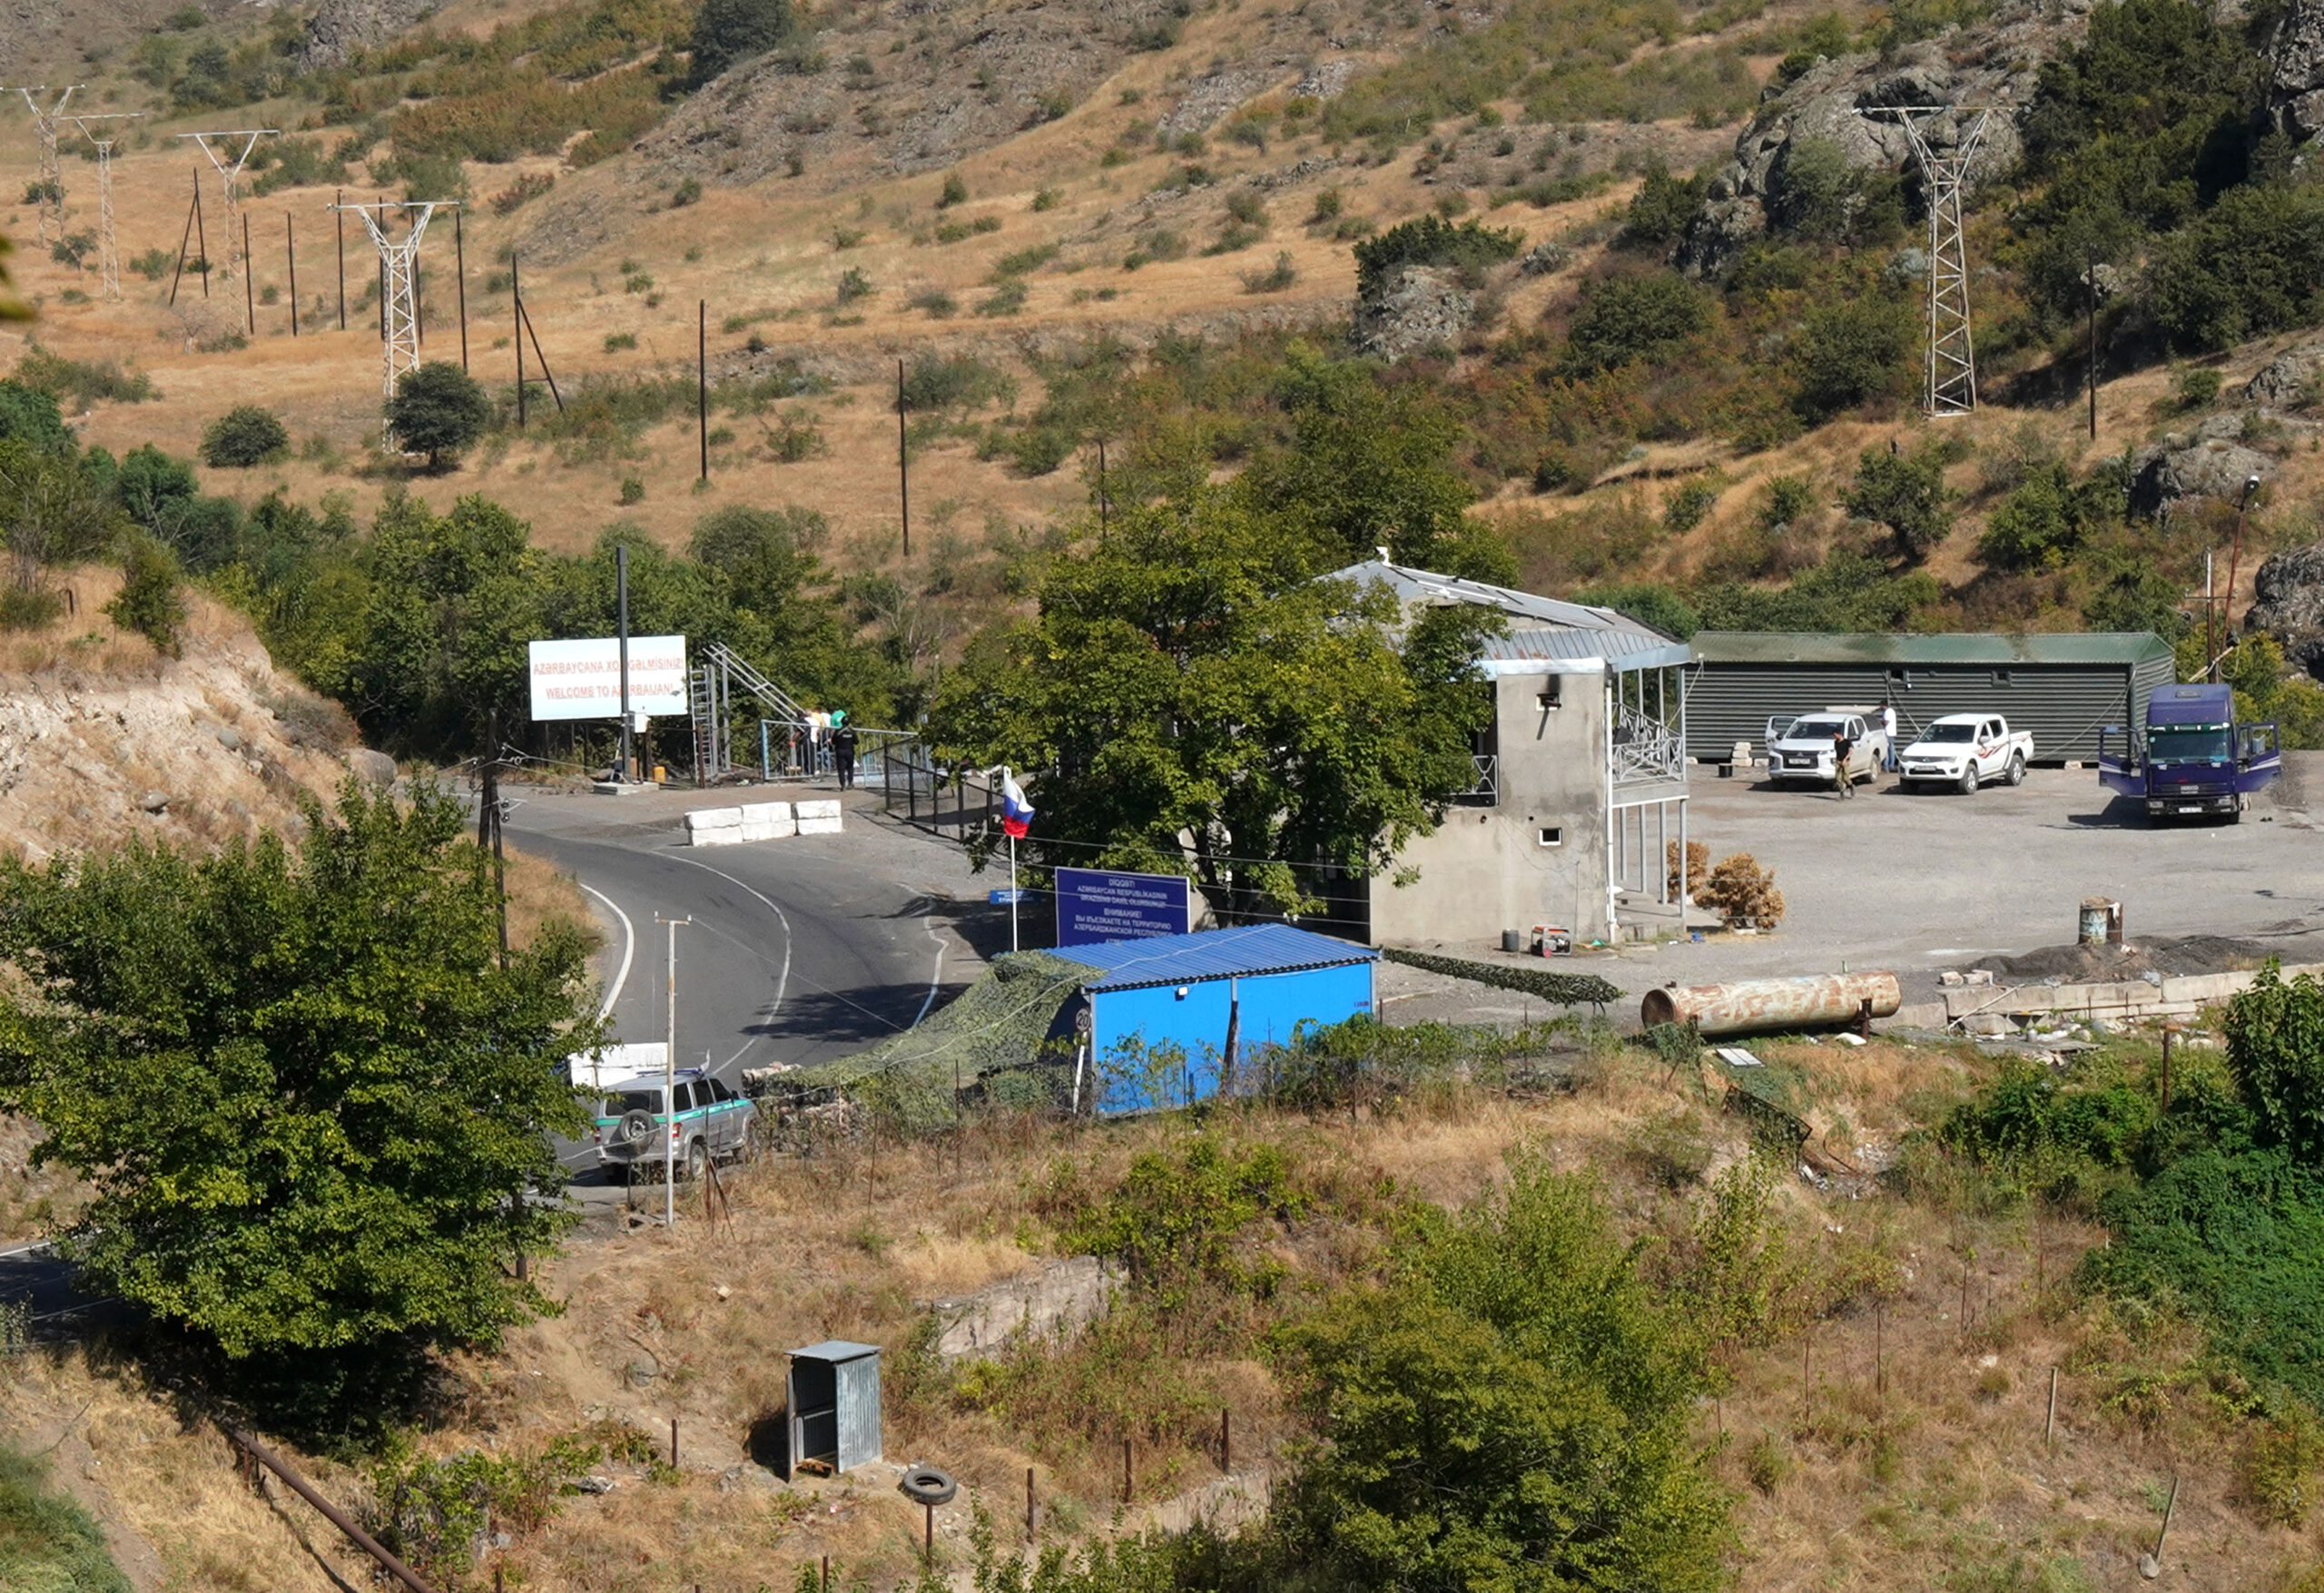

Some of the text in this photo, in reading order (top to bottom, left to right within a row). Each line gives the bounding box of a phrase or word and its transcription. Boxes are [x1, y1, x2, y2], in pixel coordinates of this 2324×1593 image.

[534, 660, 604, 675] AZƏRBAYCANA
[606, 659, 623, 673] XO
[546, 683, 674, 700] WELCOME TO AZRBAIJAN!
[1078, 1012, 1088, 1028] 20
